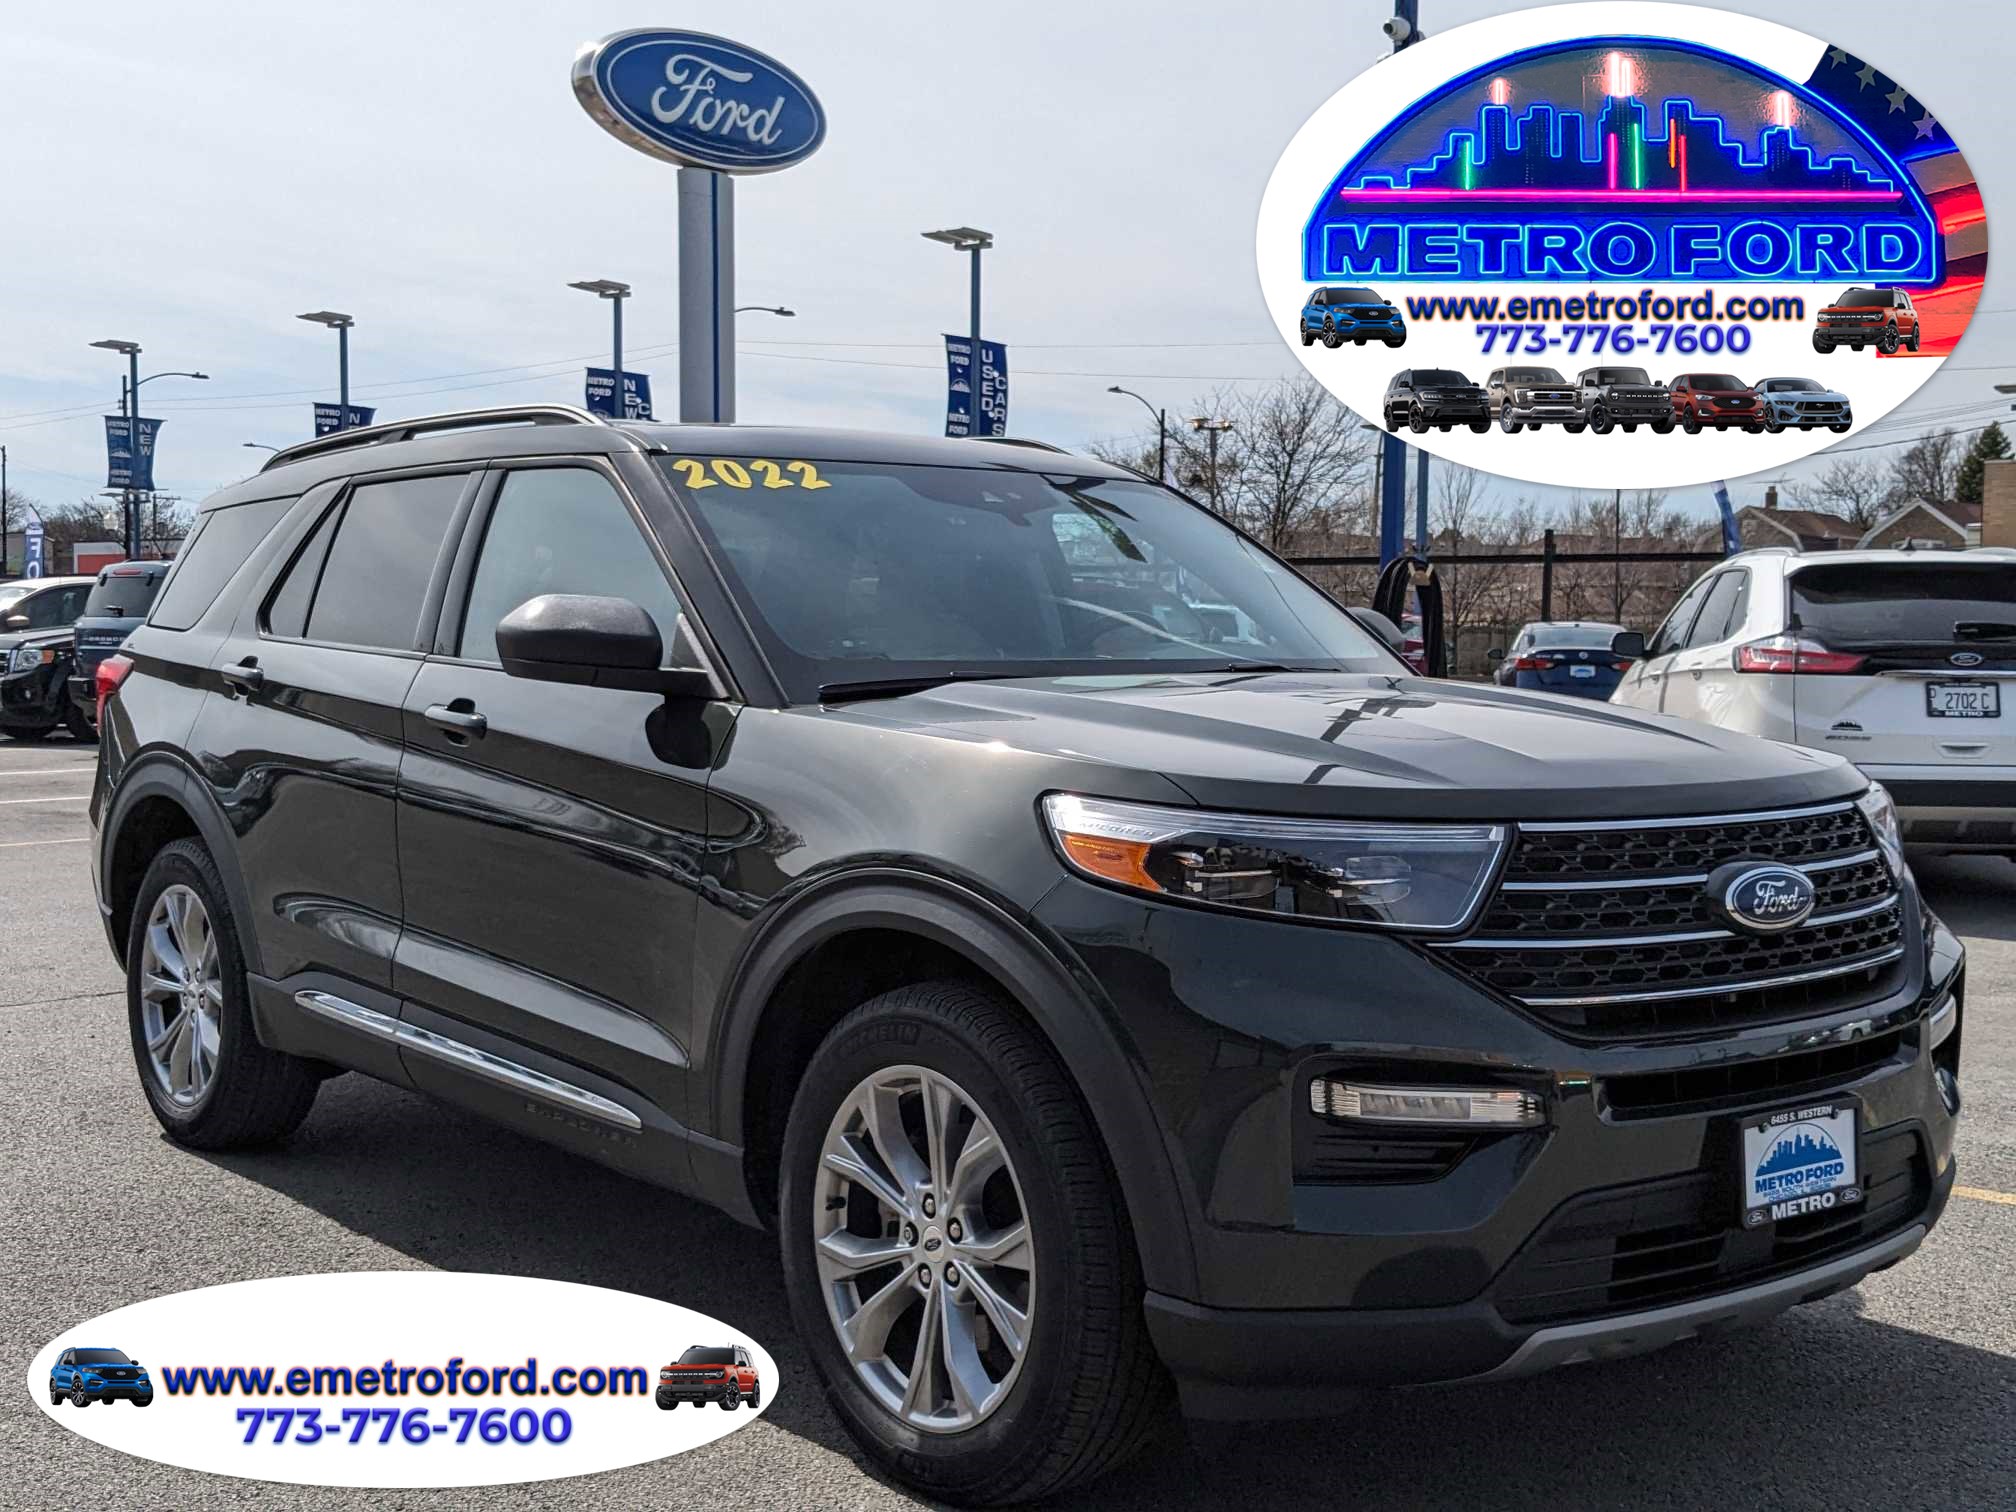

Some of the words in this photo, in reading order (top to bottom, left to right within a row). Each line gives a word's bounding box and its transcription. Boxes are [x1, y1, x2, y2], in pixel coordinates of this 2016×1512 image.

[651, 54, 785, 144] Ford
[982, 349, 994, 411] USED
[992, 377, 1007, 436] CARS
[139, 423, 152, 456] NEW
[671, 459, 833, 490] 2022
[1945, 692, 1977, 710] 2702
[1981, 692, 1990, 710] C
[1753, 880, 1803, 915] Ford
[1797, 1105, 1833, 1120] WESTERN
[1755, 1170, 1804, 1194] METRO
[1805, 1161, 1844, 1181] FORD
[1771, 1191, 1836, 1220] METRO
